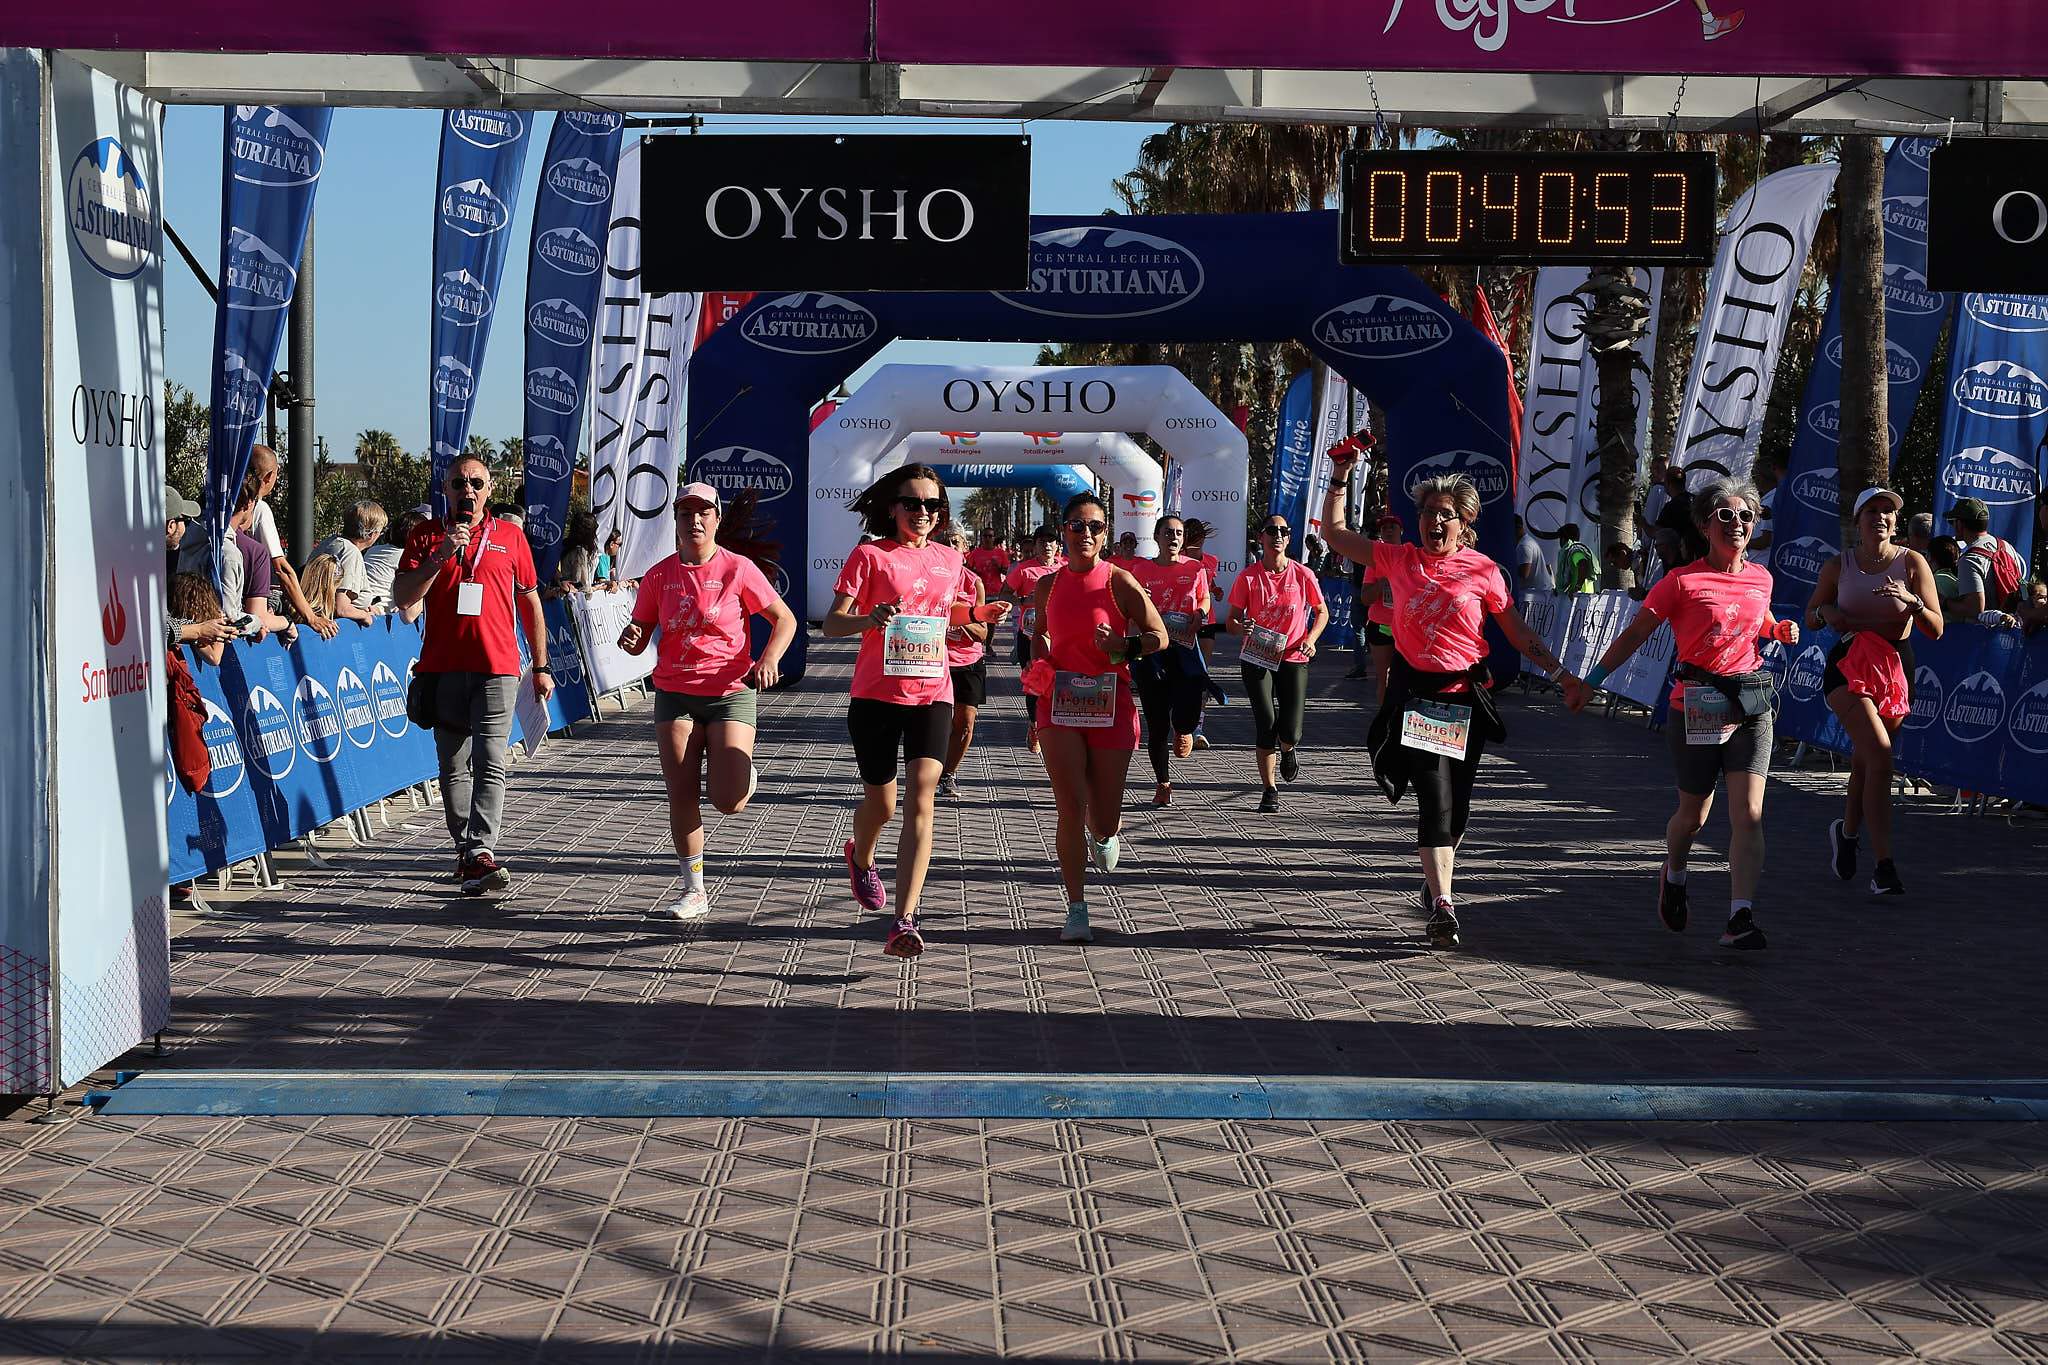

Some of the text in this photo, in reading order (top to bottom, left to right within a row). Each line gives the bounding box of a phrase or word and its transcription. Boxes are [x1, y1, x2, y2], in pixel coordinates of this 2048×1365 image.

[74, 176, 149, 252] ASTURIANA
[705, 186, 974, 242] OYSHO
[1368, 170, 1687, 244] 00:40:53
[541, 237, 597, 269] ASTURIANA
[1034, 252, 1182, 265] CENTRAL LECHERA
[1030, 267, 1188, 295] STURIANA
[533, 308, 586, 340] ASTURIANA
[748, 314, 867, 339] ASTURIANA
[771, 311, 865, 321] CENTRAL LECHERA
[1323, 320, 1445, 344] ASTURIANA
[1341, 314, 1437, 325] CENTRAL LECHERA
[943, 379, 1116, 414] OYSHO
[1960, 377, 2043, 410] ASTURIANA
[72, 384, 154, 451] OYSHO
[839, 417, 891, 431] OYSHO
[1165, 416, 1218, 431] OYSHO
[1525, 294, 1588, 540] OYSHO
[939, 447, 1065, 456] TotalEnergies TotalEnergies
[1281, 419, 1312, 498] Marlene
[815, 487, 863, 500] OYSHO
[1946, 464, 2034, 496] ASTURIANA
[1191, 490, 1240, 503] OYSHO
[1569, 608, 1616, 646] OYSHO
[81, 659, 150, 703] Santander
[341, 699, 375, 730] ASTURIANA
[375, 690, 408, 721] ASTURIANA
[1947, 695, 1998, 726] ASTURIANA
[251, 727, 294, 760] ASTURIANA
[298, 711, 341, 745] ASTURIANA
